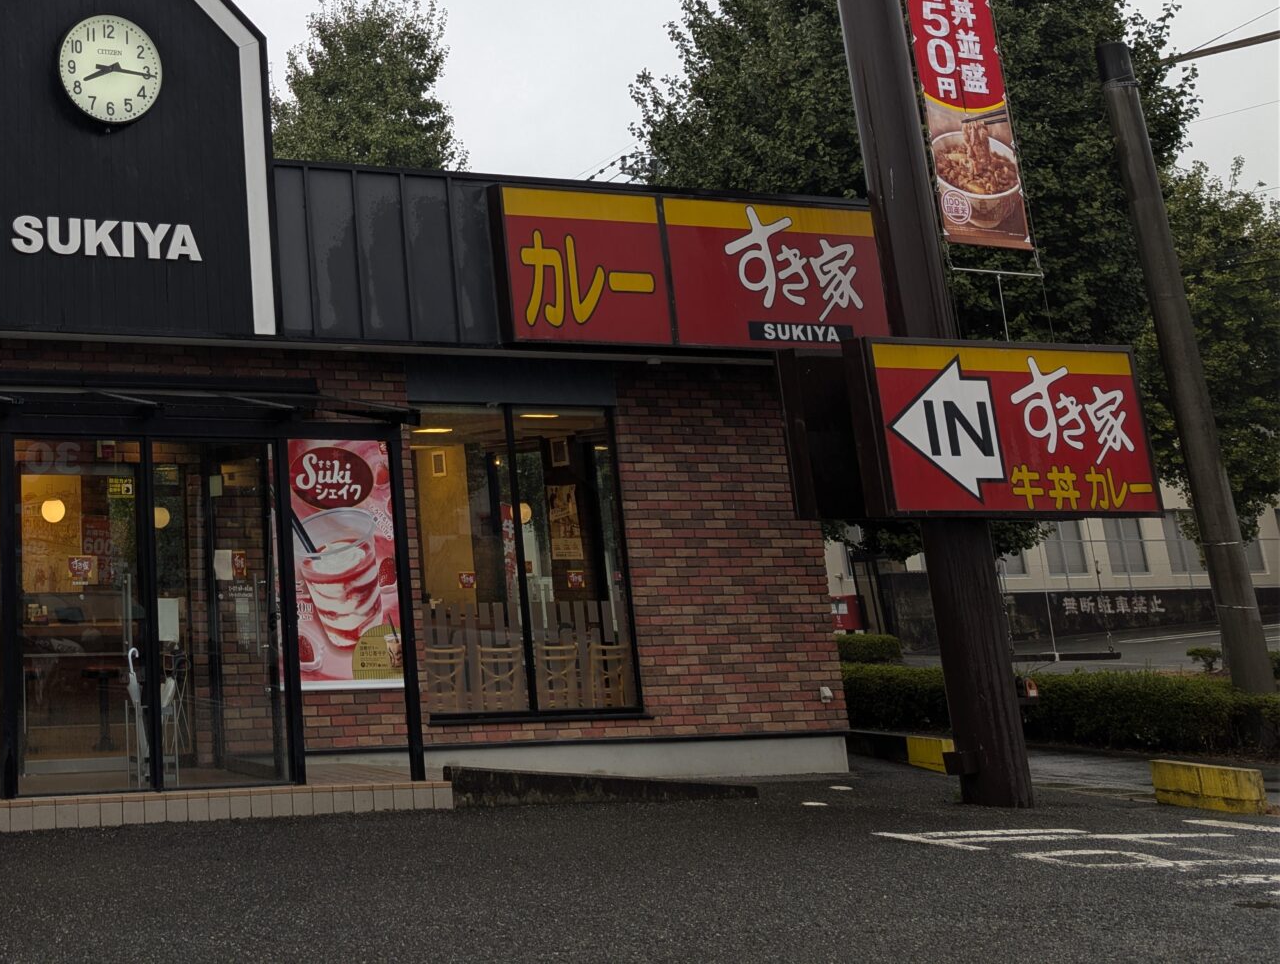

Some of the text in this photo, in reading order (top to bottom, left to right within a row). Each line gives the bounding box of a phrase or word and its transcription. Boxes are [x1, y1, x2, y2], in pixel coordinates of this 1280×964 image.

[86, 27, 96, 42] 11
[102, 23, 116, 40] 12
[124, 30, 130, 45] 1
[70, 39, 83, 54] 10
[97, 48, 123, 56] CITIZEN
[136, 45, 145, 60] 2
[67, 59, 76, 75] 9
[142, 65, 151, 81] 3
[72, 80, 83, 95] 8
[136, 85, 147, 100] 4
[87, 95, 97, 111] 7
[106, 101, 116, 117] 6
[123, 98, 133, 113] 5
[11, 214, 203, 262] SUKIYA
[724, 204, 864, 323] すき家
[520, 228, 656, 328] カレー
[763, 323, 840, 343] SUKIYA
[1010, 355, 1135, 465] すき家
[923, 399, 995, 457] IN
[295, 452, 353, 490] Suki
[315, 483, 362, 501] シェイク
[1010, 465, 1153, 511] 牛丼 カレー
[1061, 594, 1167, 616] 無断駐車禁止
